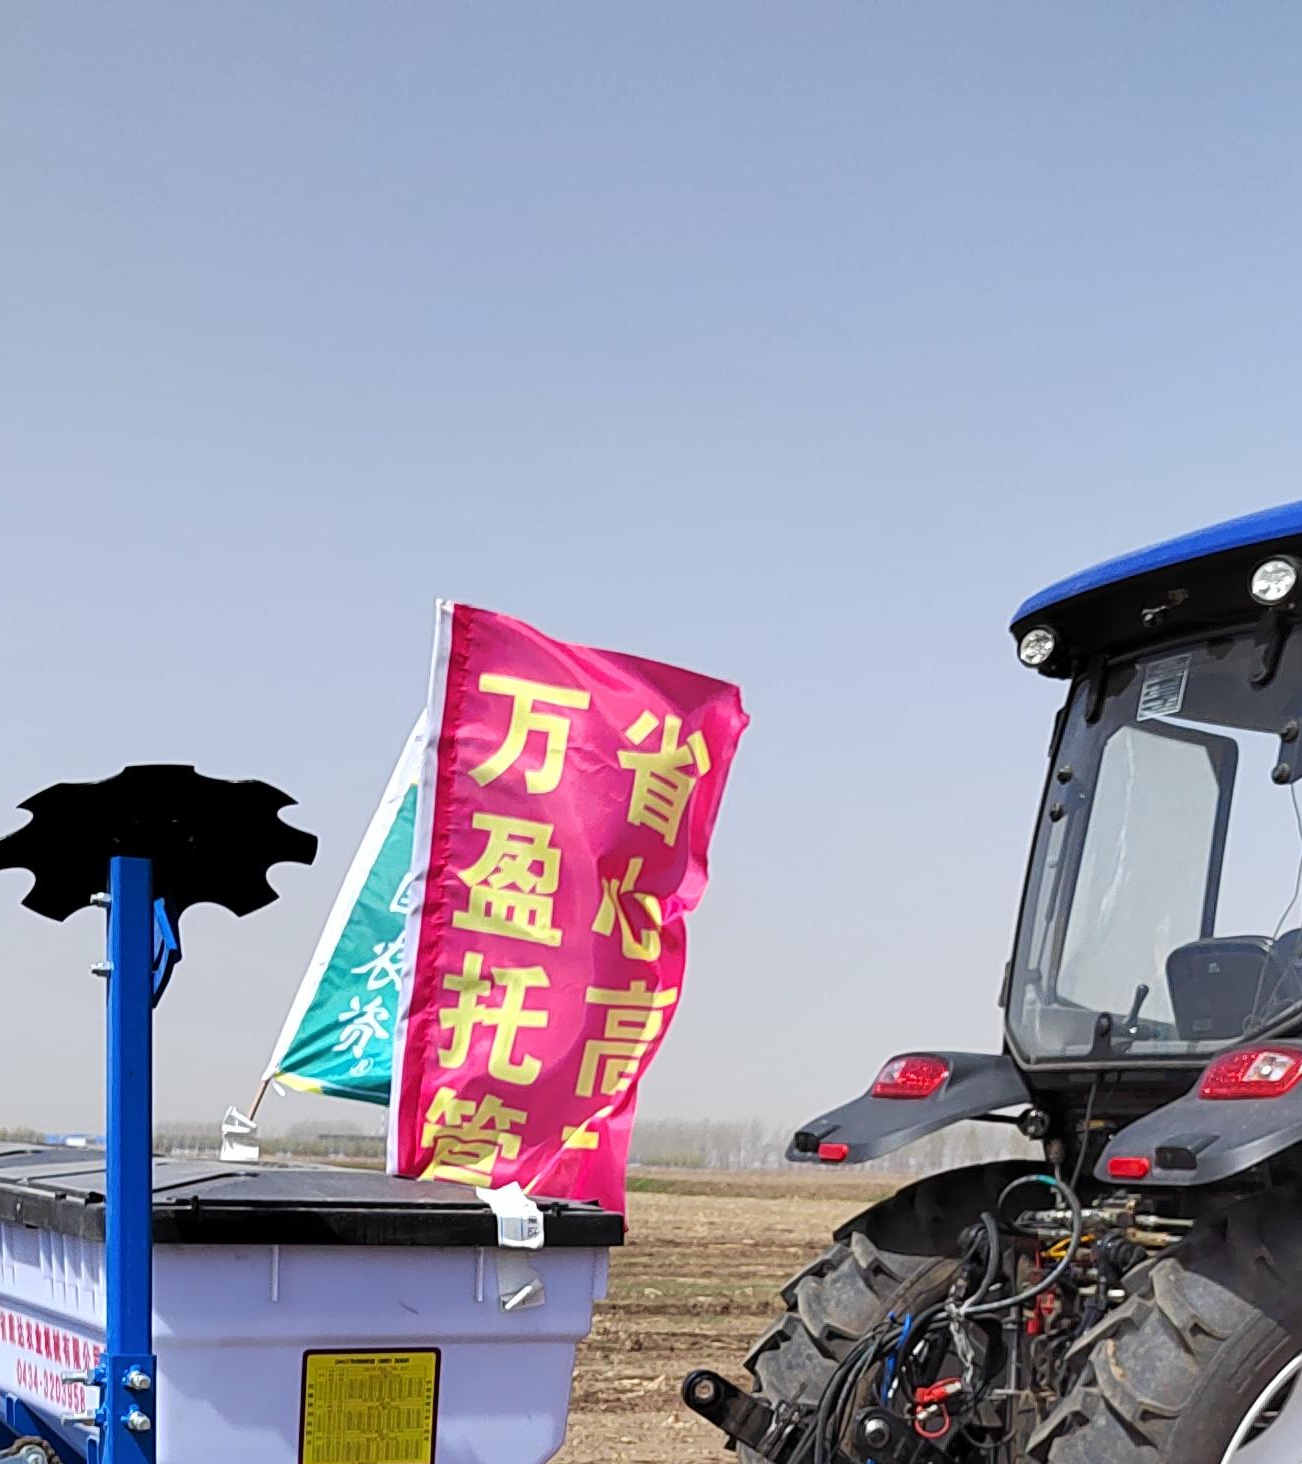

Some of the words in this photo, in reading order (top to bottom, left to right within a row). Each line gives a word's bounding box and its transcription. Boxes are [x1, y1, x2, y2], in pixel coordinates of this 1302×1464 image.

[419, 673, 591, 1187] 万盈托管
[561, 712, 712, 1150] 省心高
